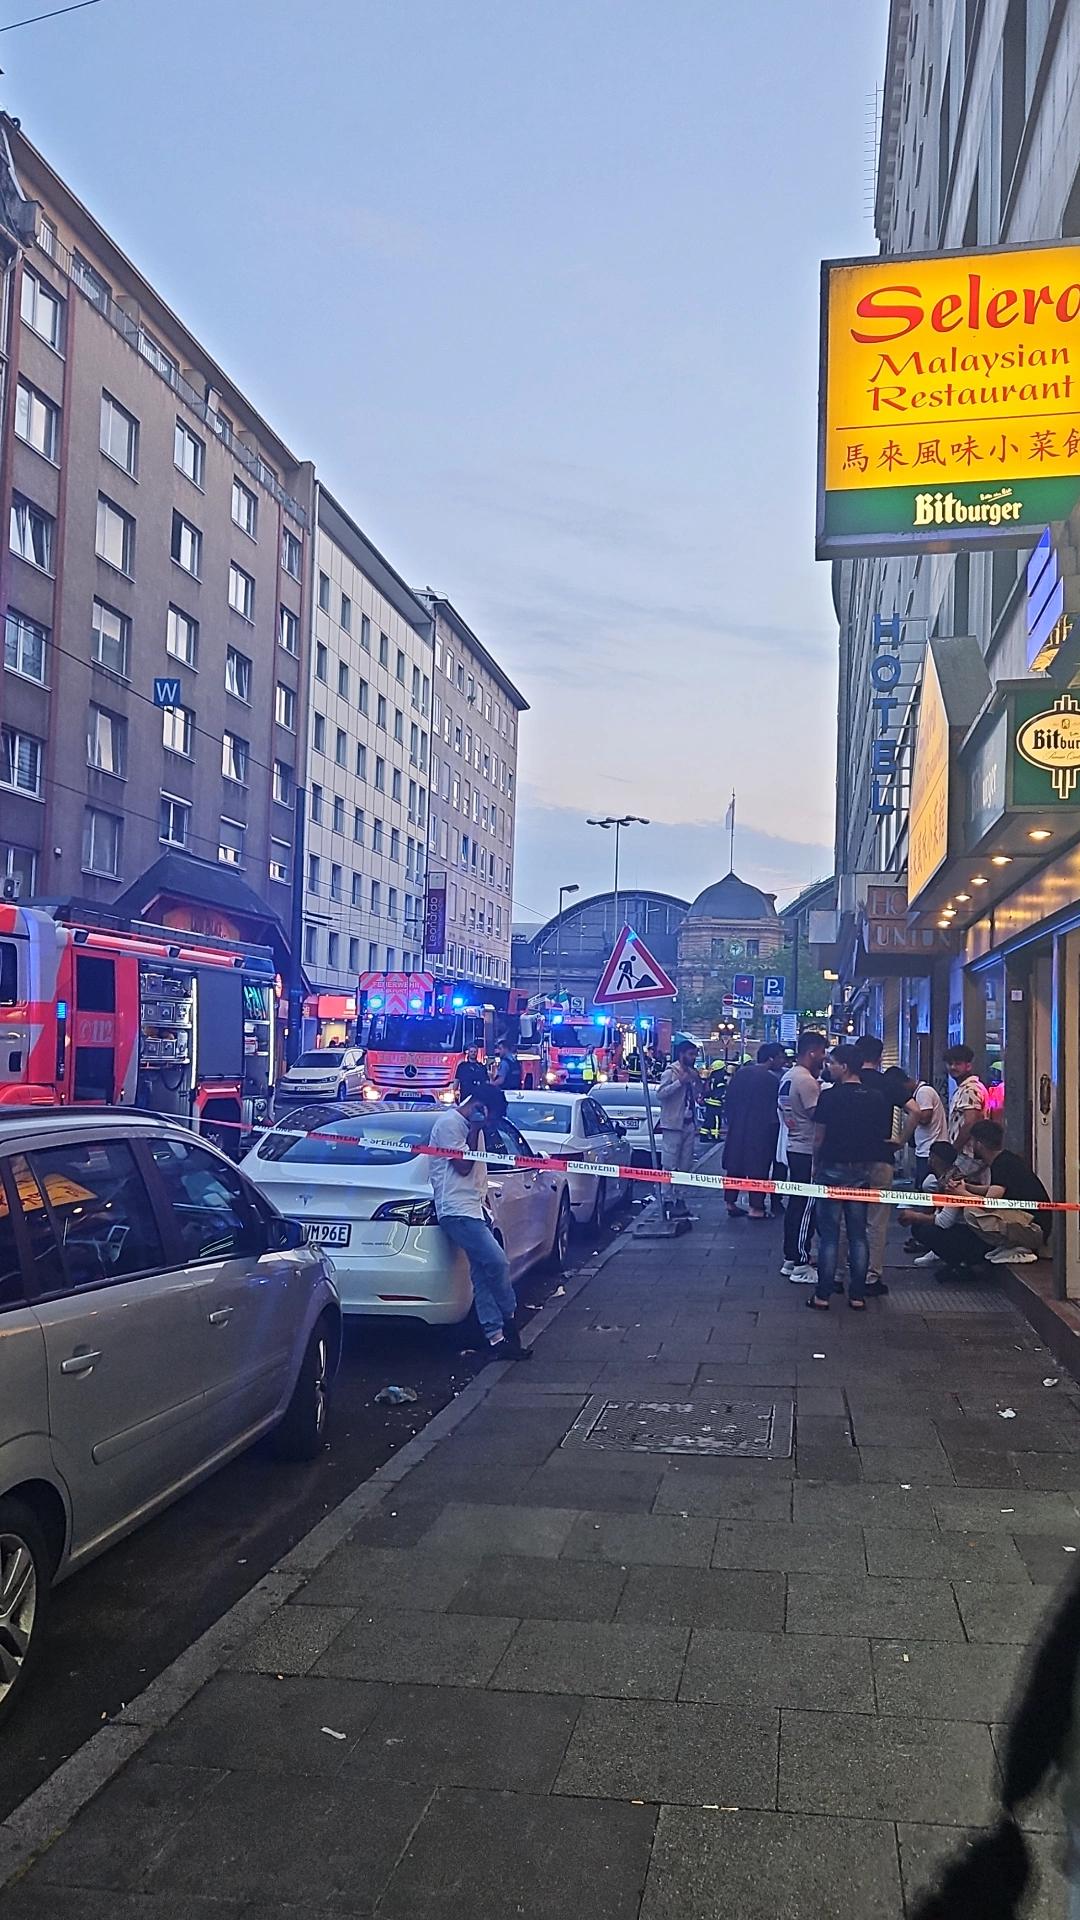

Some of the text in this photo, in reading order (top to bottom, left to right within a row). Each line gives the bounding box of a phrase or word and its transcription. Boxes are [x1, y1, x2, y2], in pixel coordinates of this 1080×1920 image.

[867, 344, 1070, 383] Malaysian
[866, 375, 1075, 412] Restaurant
[913, 492, 1023, 526] Bitburger
[156, 682, 177, 702] W
[870, 612, 902, 816] HOTEL
[428, 896, 438, 947] Leonardo
[767, 979, 778, 994] P
[93, 1020, 112, 1042] 112
[376, 1054, 447, 1065] FEUERWEHR
[880, 1190, 931, 1201] SPERRZONE
[322, 1226, 347, 1241] 96E
